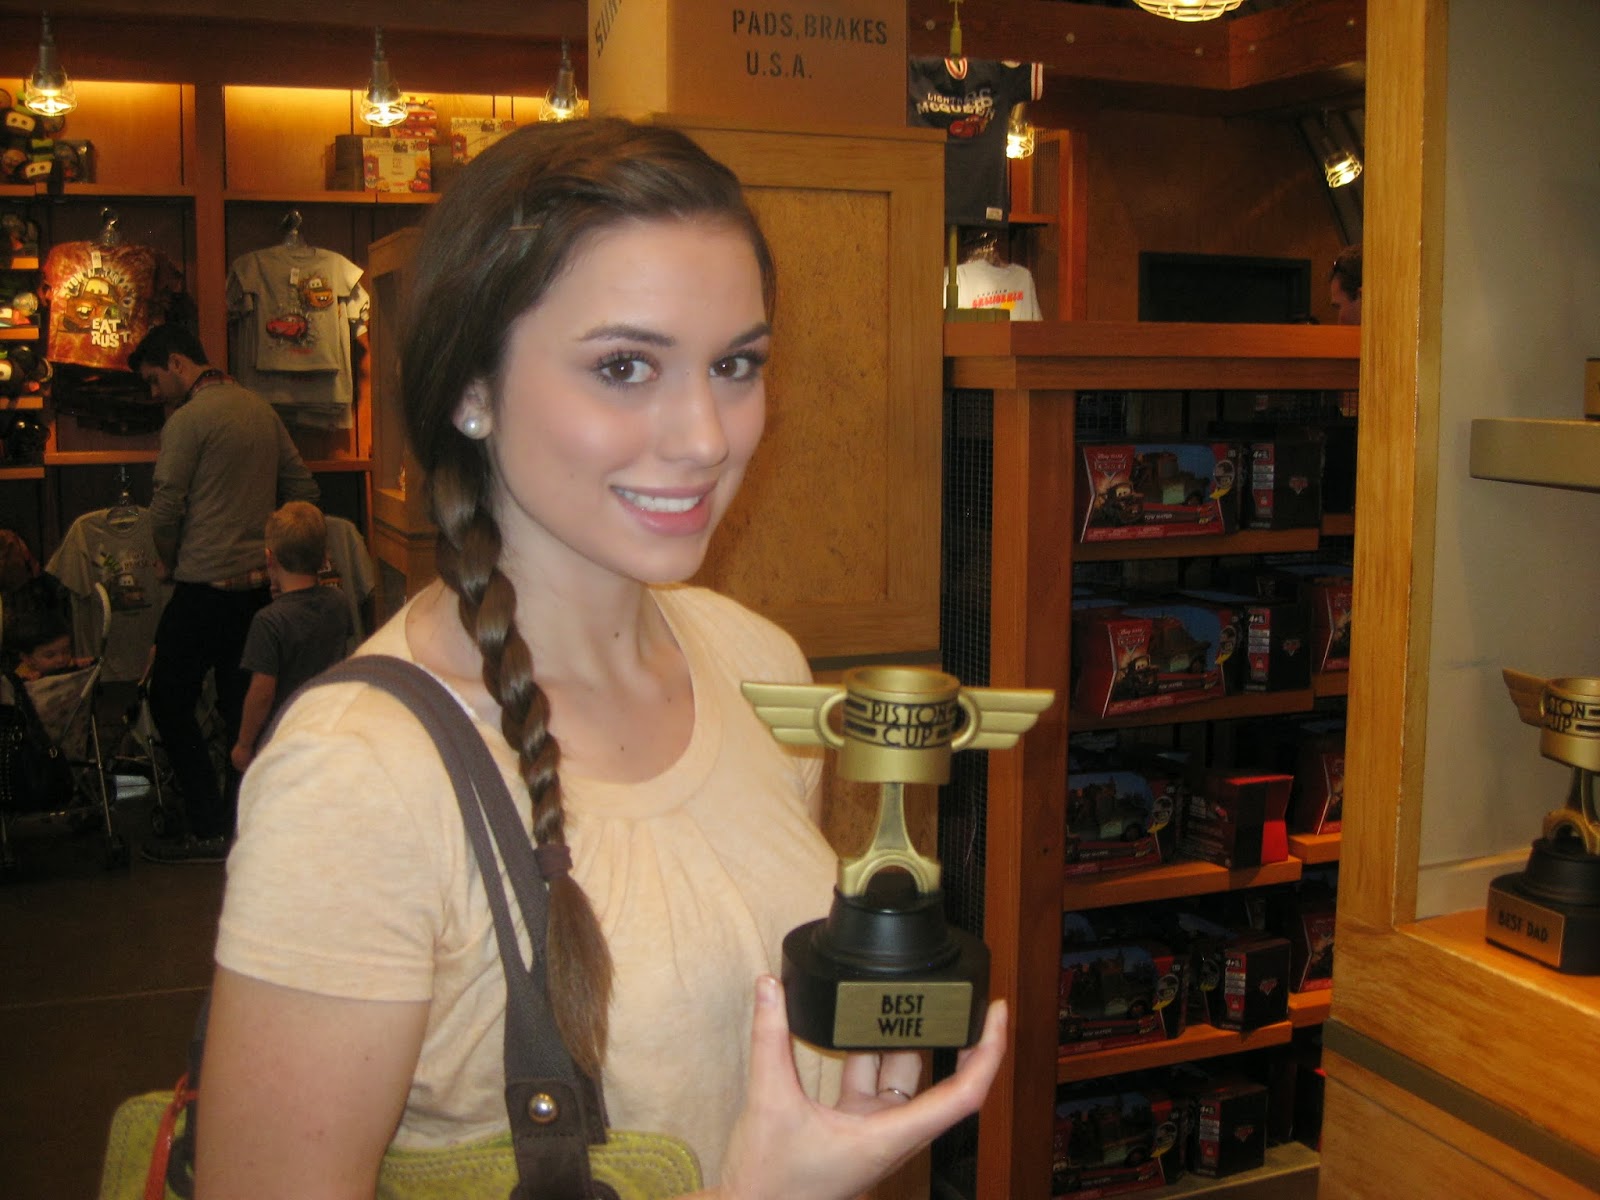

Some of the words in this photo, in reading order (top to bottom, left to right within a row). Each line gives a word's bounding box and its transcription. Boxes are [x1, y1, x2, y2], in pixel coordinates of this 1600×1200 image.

[804, 13, 888, 45] BRAKES
[746, 50, 813, 79] U.S.A.
[92, 318, 121, 334] EAT
[91, 330, 131, 348] RUST
[883, 726, 932, 748] CUP
[1499, 910, 1522, 932] BEST
[1526, 921, 1549, 944] DAD
[881, 994, 925, 1015] BEST
[877, 1017, 924, 1038] WIFE
